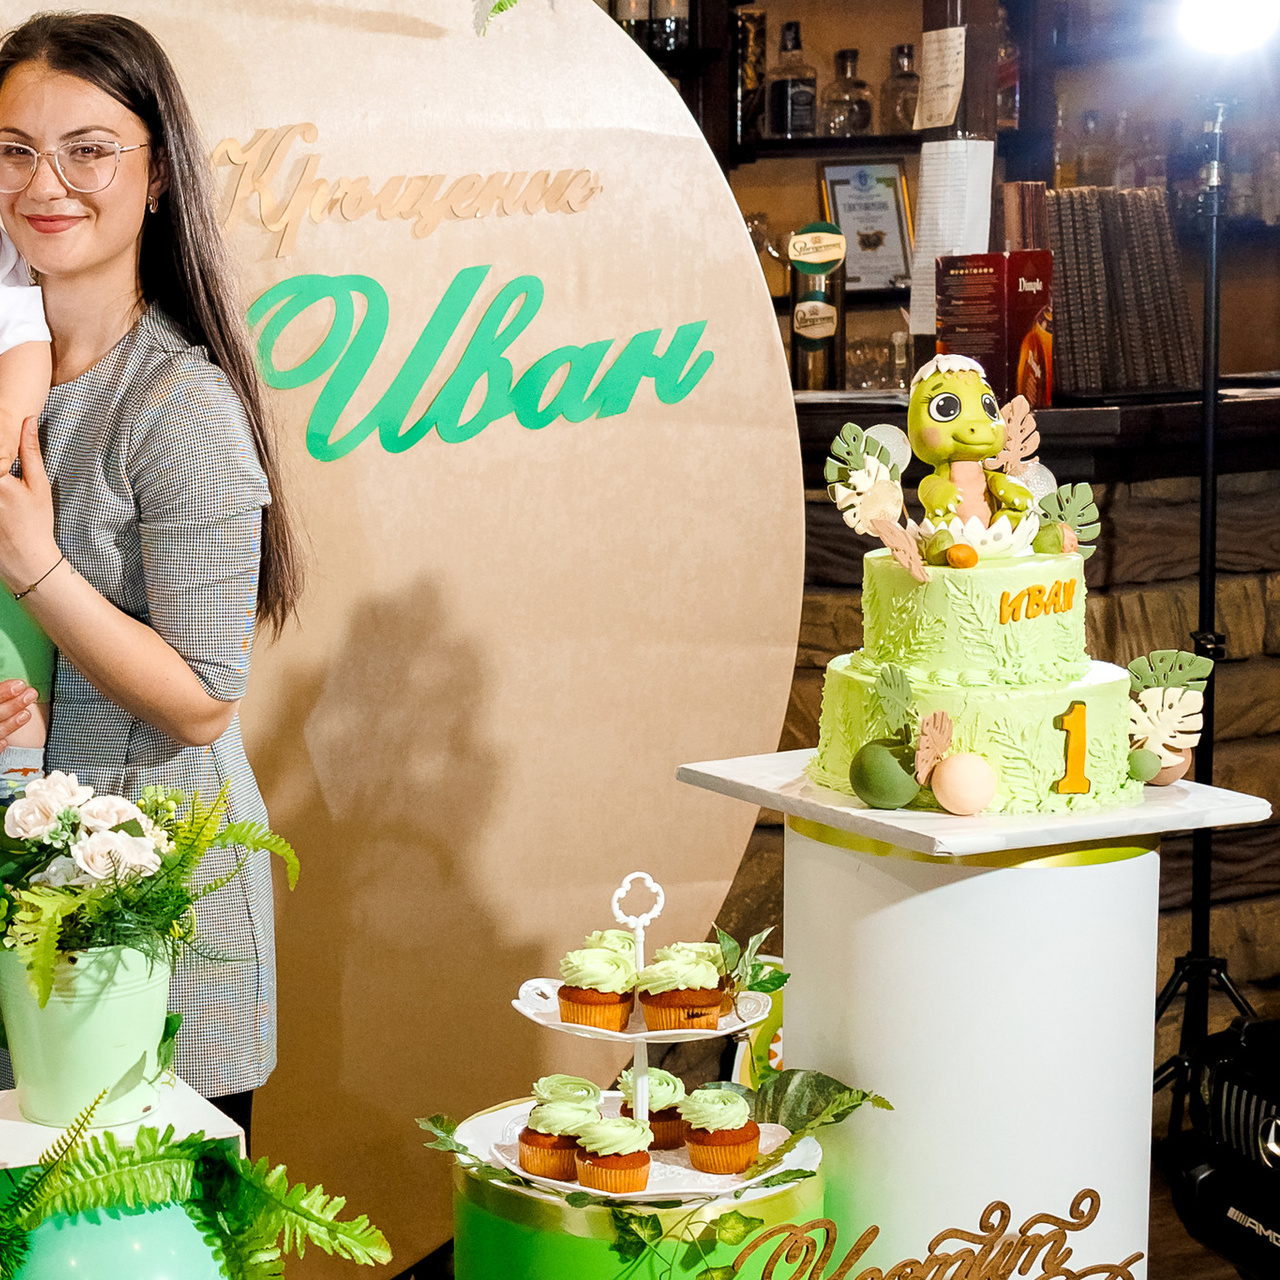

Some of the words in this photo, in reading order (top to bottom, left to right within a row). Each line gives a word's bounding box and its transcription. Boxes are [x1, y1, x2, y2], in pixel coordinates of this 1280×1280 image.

[245, 264, 715, 463] Иван
[999, 578, 1078, 625] ИВАН
[1050, 700, 1091, 795] 1
